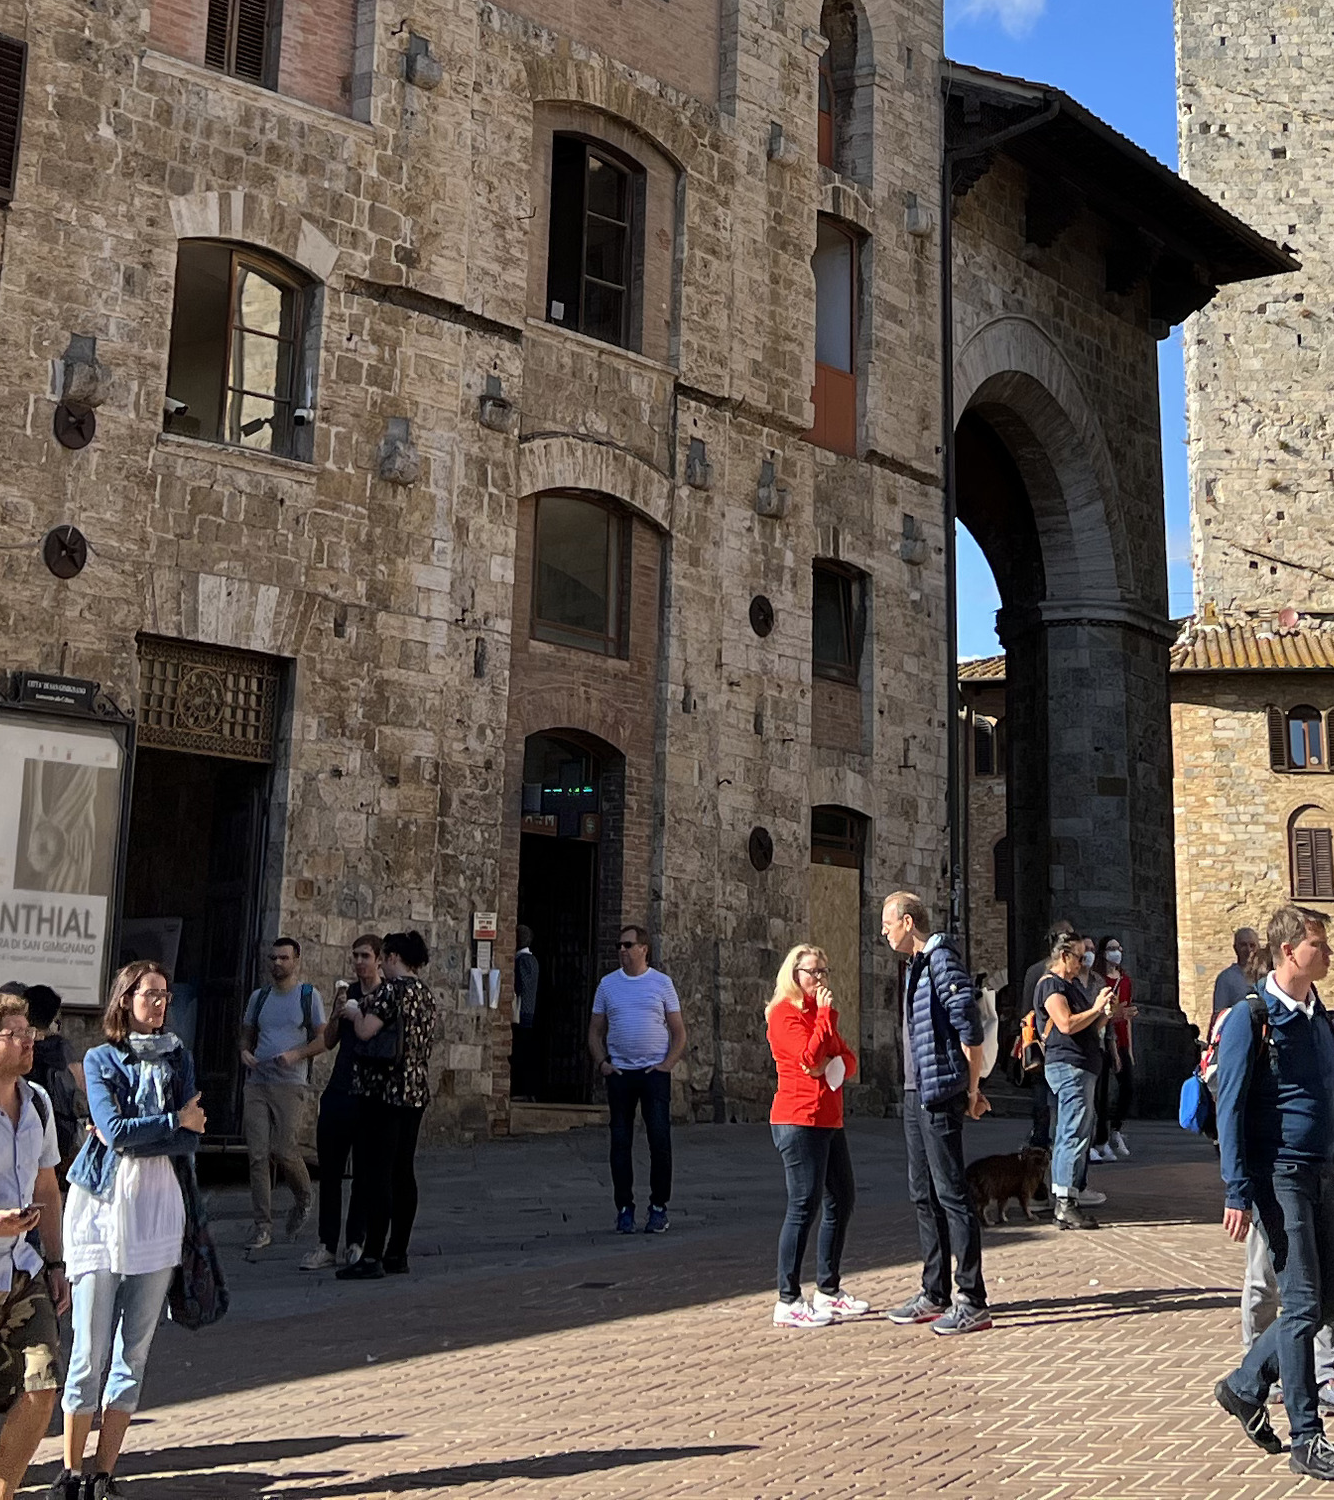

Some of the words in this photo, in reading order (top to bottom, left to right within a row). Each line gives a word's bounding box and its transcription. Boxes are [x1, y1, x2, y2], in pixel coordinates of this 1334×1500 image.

[11, 938, 20, 950] DI
[22, 939, 41, 951] SAN
[42, 941, 96, 955] GIMIGNANO
